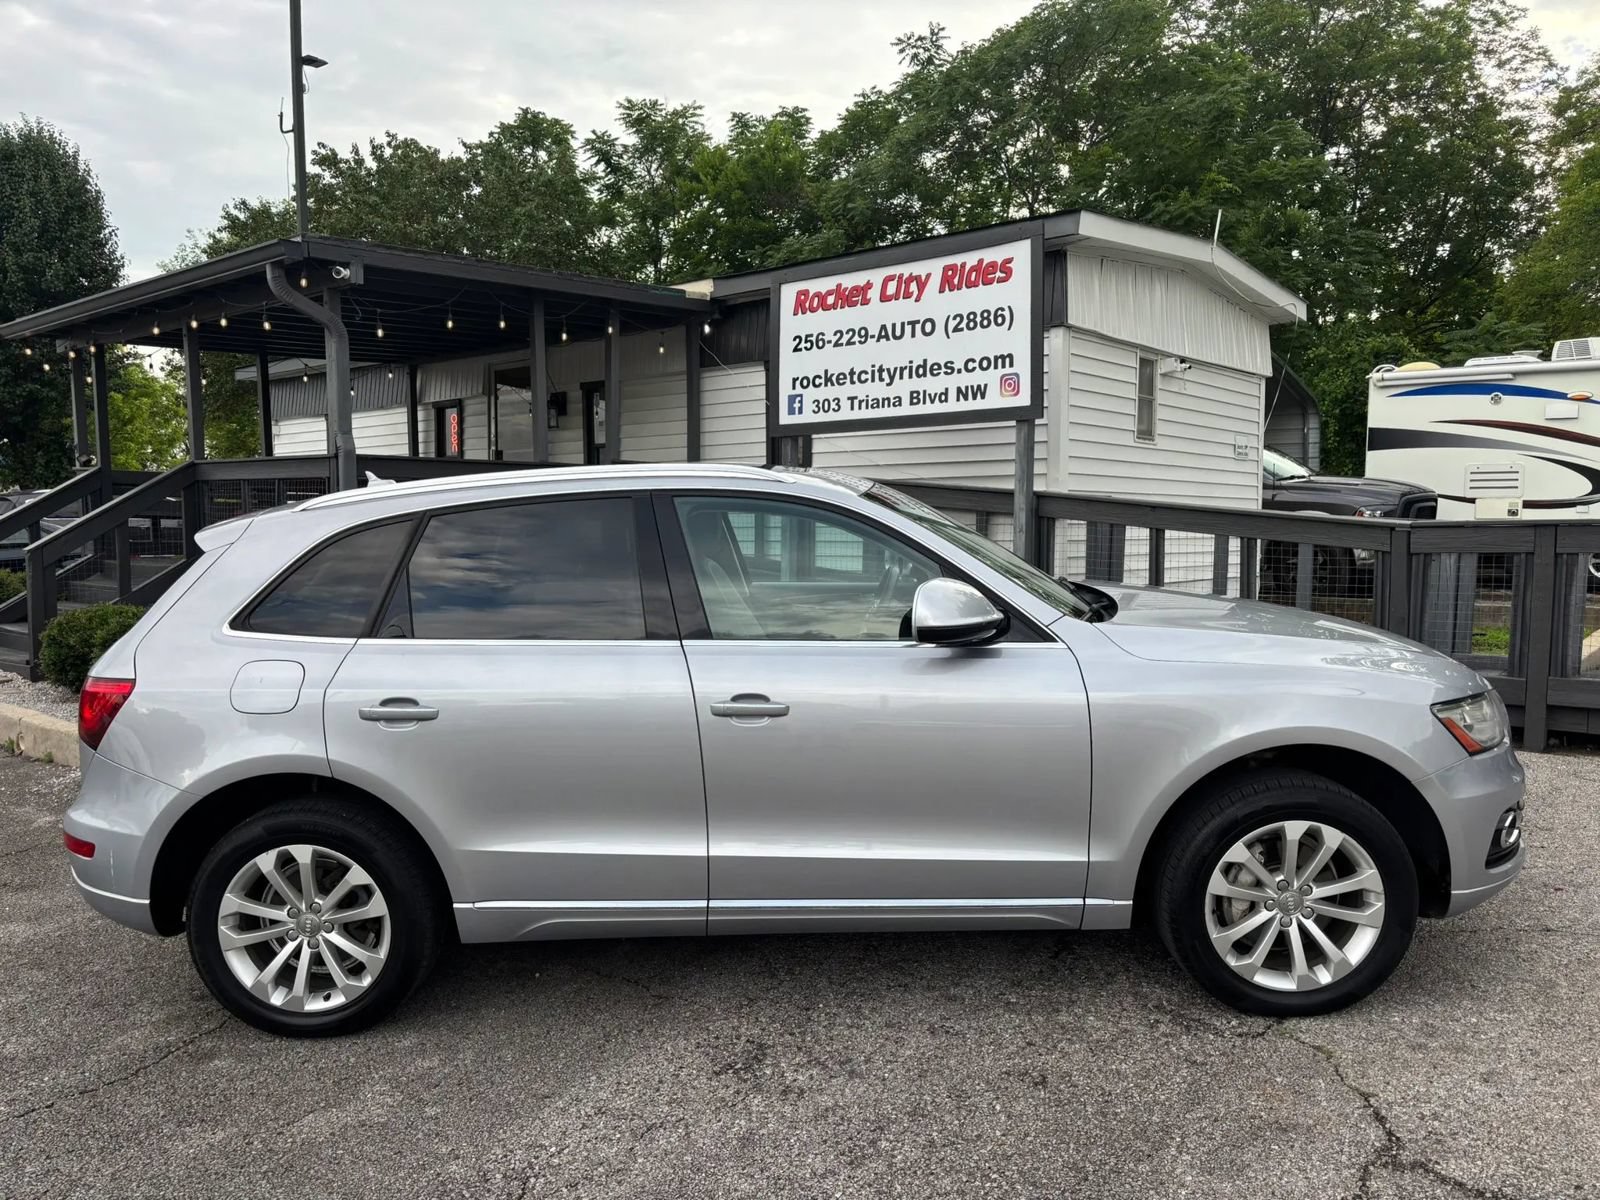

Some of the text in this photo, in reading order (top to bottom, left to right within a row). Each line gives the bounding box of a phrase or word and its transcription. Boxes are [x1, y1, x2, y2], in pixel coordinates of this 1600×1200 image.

[793, 256, 1014, 316] Rocket City Rides
[792, 305, 1014, 353] 256-229-AUTO (2886)
[791, 353, 1014, 390] rocketcityrides.com
[812, 383, 988, 414] 303 Triana Blvd NW
